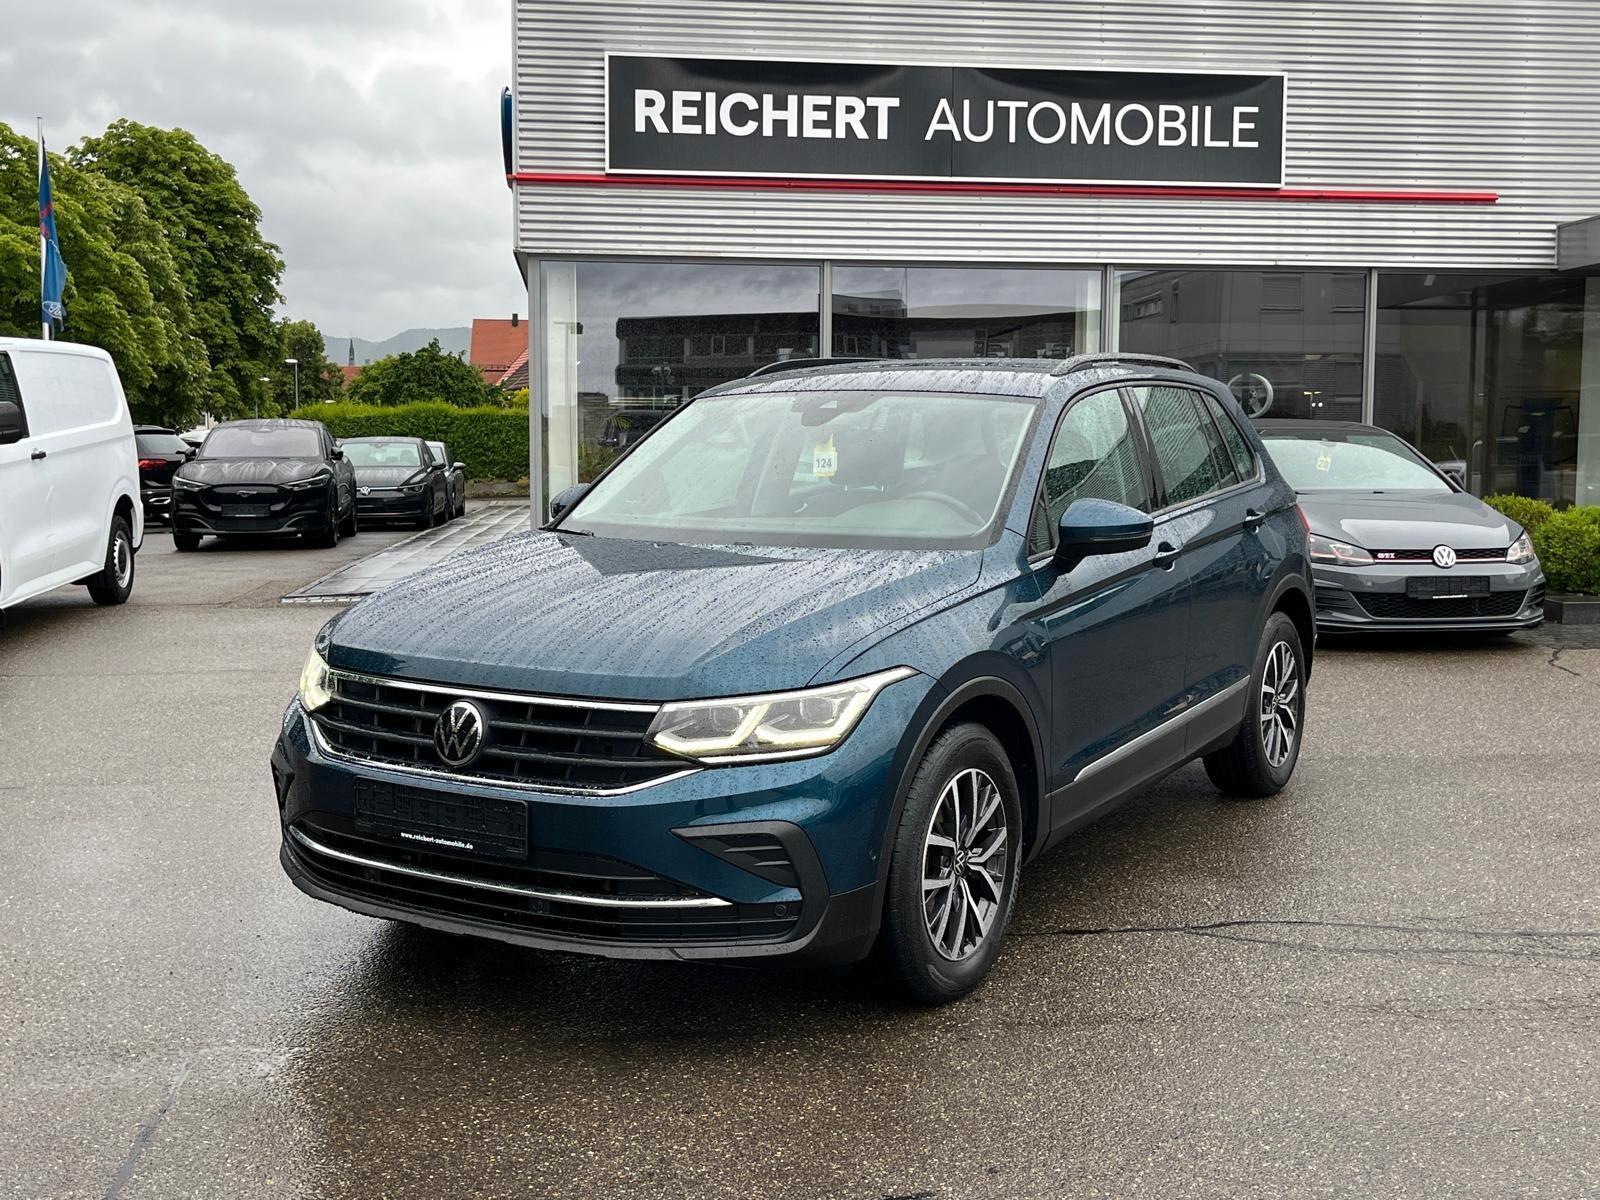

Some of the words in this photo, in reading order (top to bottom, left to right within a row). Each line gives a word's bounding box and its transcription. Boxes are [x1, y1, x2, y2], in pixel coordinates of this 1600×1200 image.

[633, 88, 900, 140] REICHERT
[924, 96, 1260, 149] AUTOMOBILE
[815, 457, 832, 468] 124
[400, 831, 474, 850] www.reichert-automobile.de
